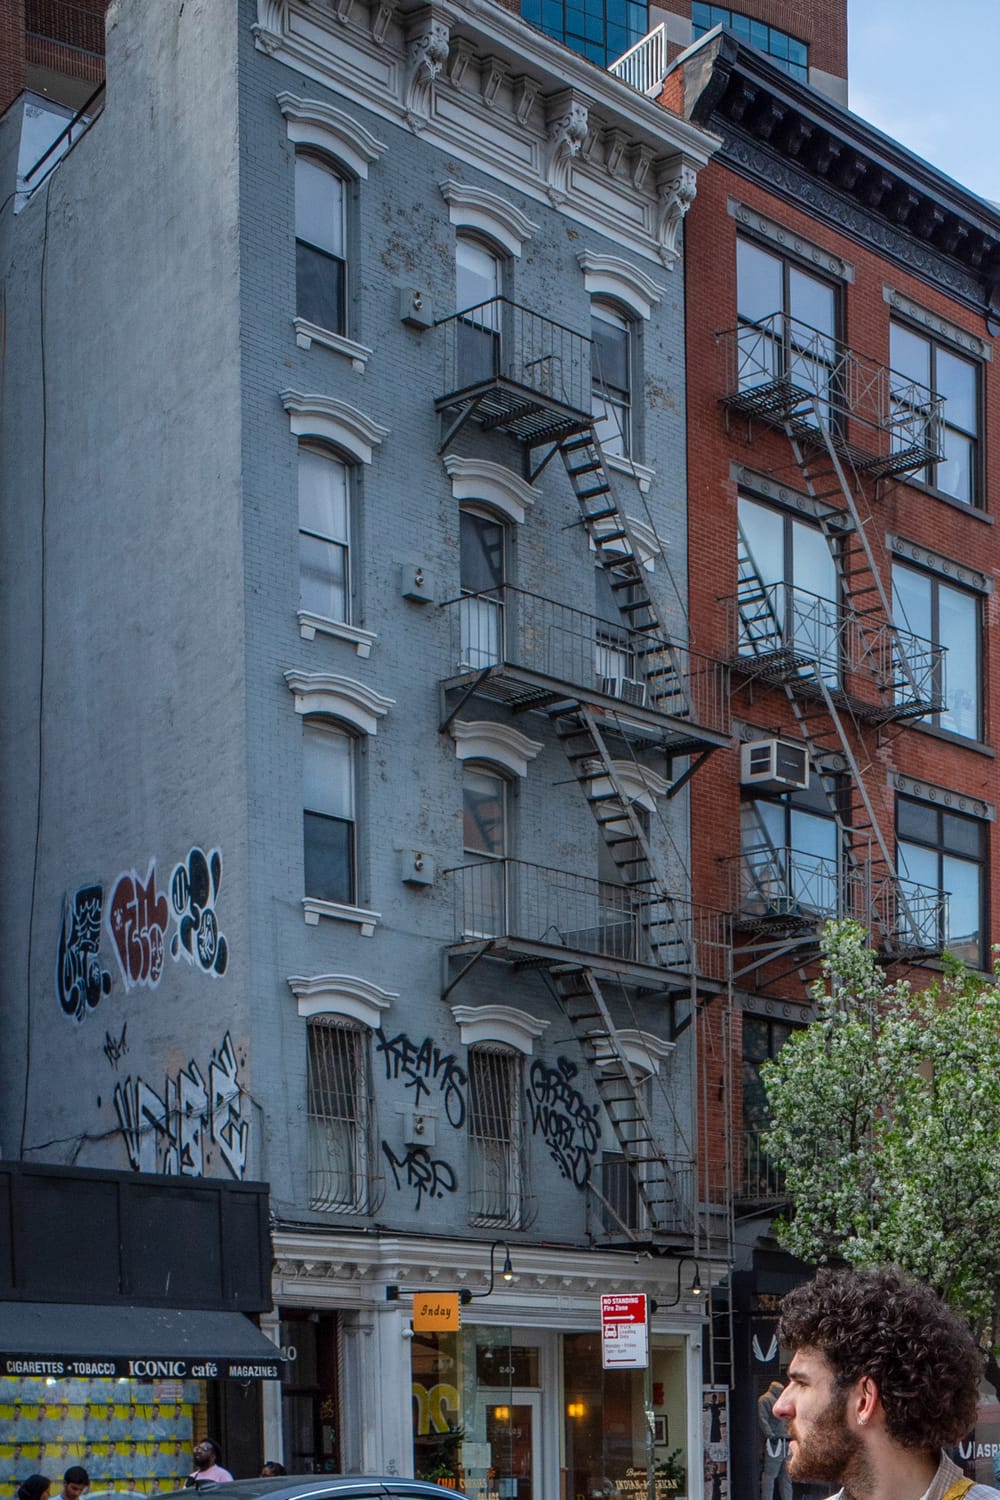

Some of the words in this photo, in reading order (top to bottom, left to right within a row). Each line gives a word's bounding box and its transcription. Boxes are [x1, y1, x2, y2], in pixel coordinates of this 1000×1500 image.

[420, 1305, 452, 1319] Inday
[6, 1361, 64, 1375] CIGARETTES
[73, 1362, 116, 1375] TOBACCO
[128, 1360, 187, 1376] ICONIC
[191, 1361, 219, 1377] café
[229, 1365, 278, 1377] MAGAZINES
